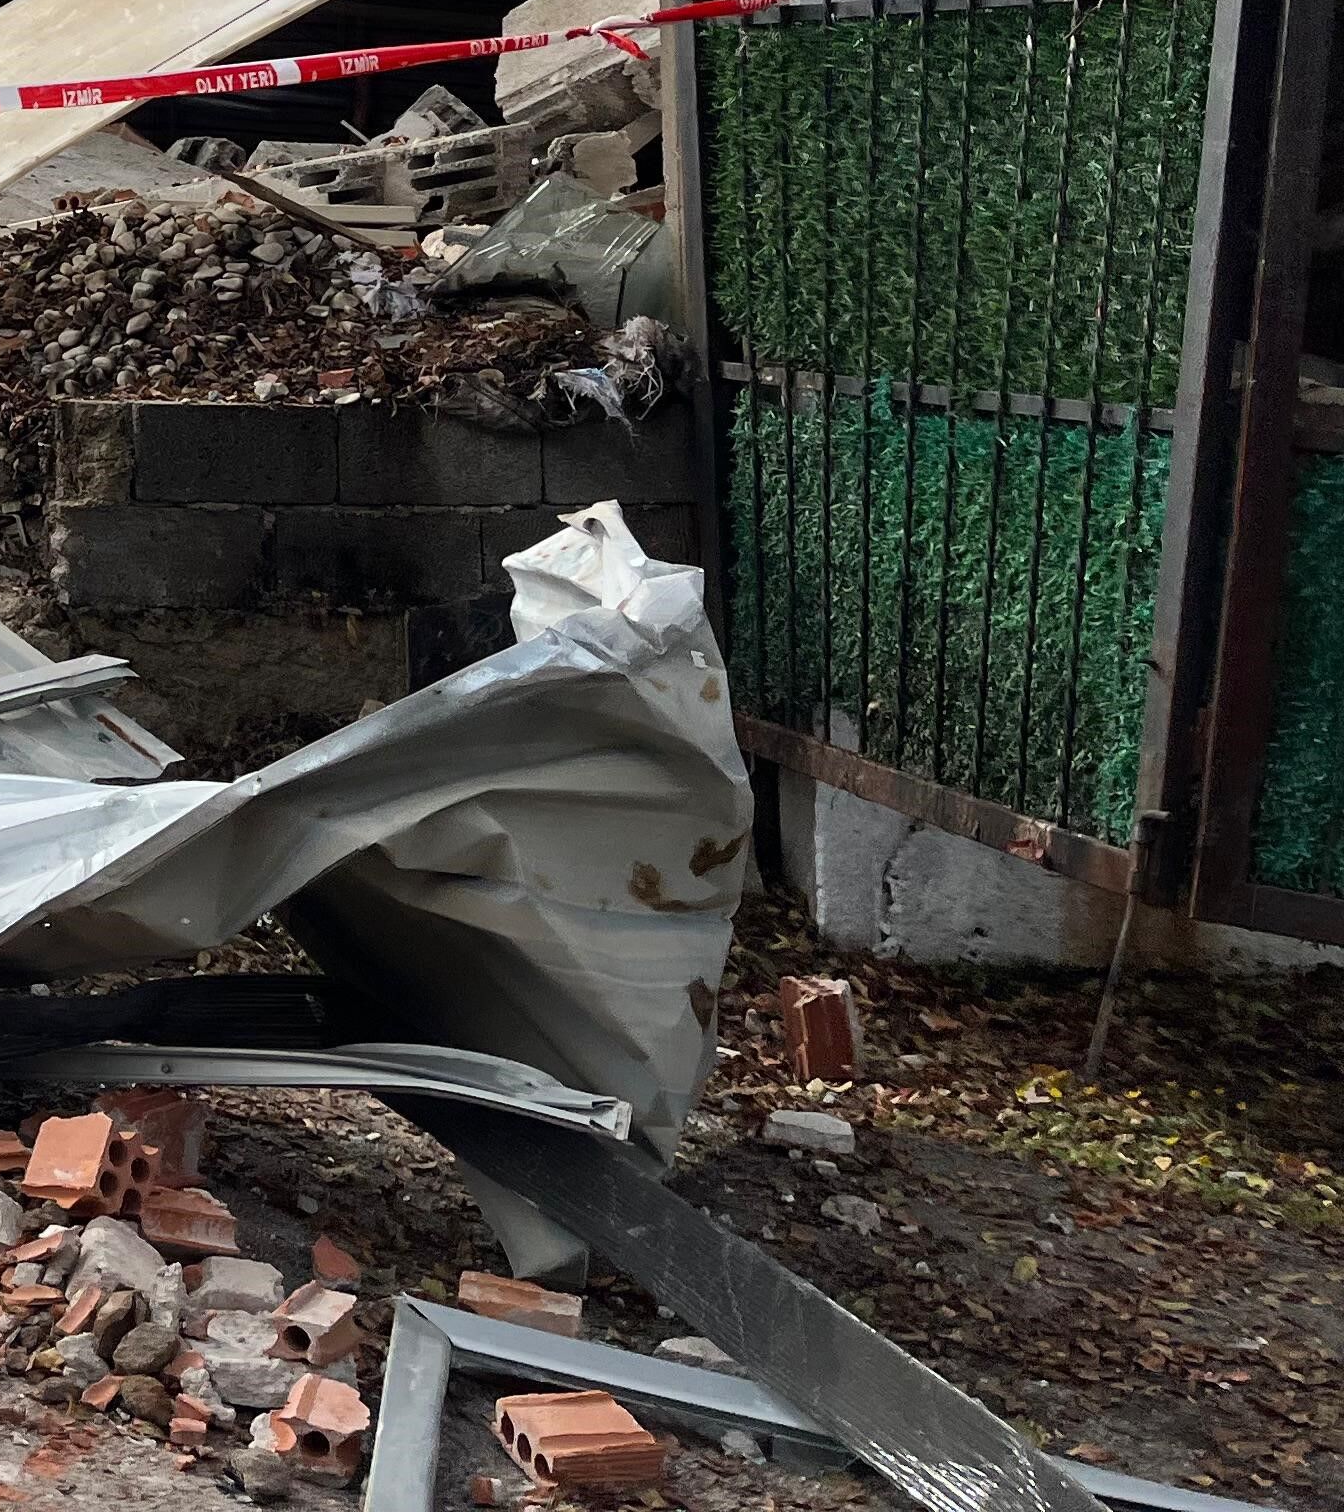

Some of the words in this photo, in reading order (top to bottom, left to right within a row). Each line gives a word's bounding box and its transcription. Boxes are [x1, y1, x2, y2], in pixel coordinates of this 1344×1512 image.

[340, 53, 380, 75] İZMİR
[63, 87, 103, 107] İZMİR
[195, 74, 234, 93] OLAY
[238, 67, 274, 90] YERİ
